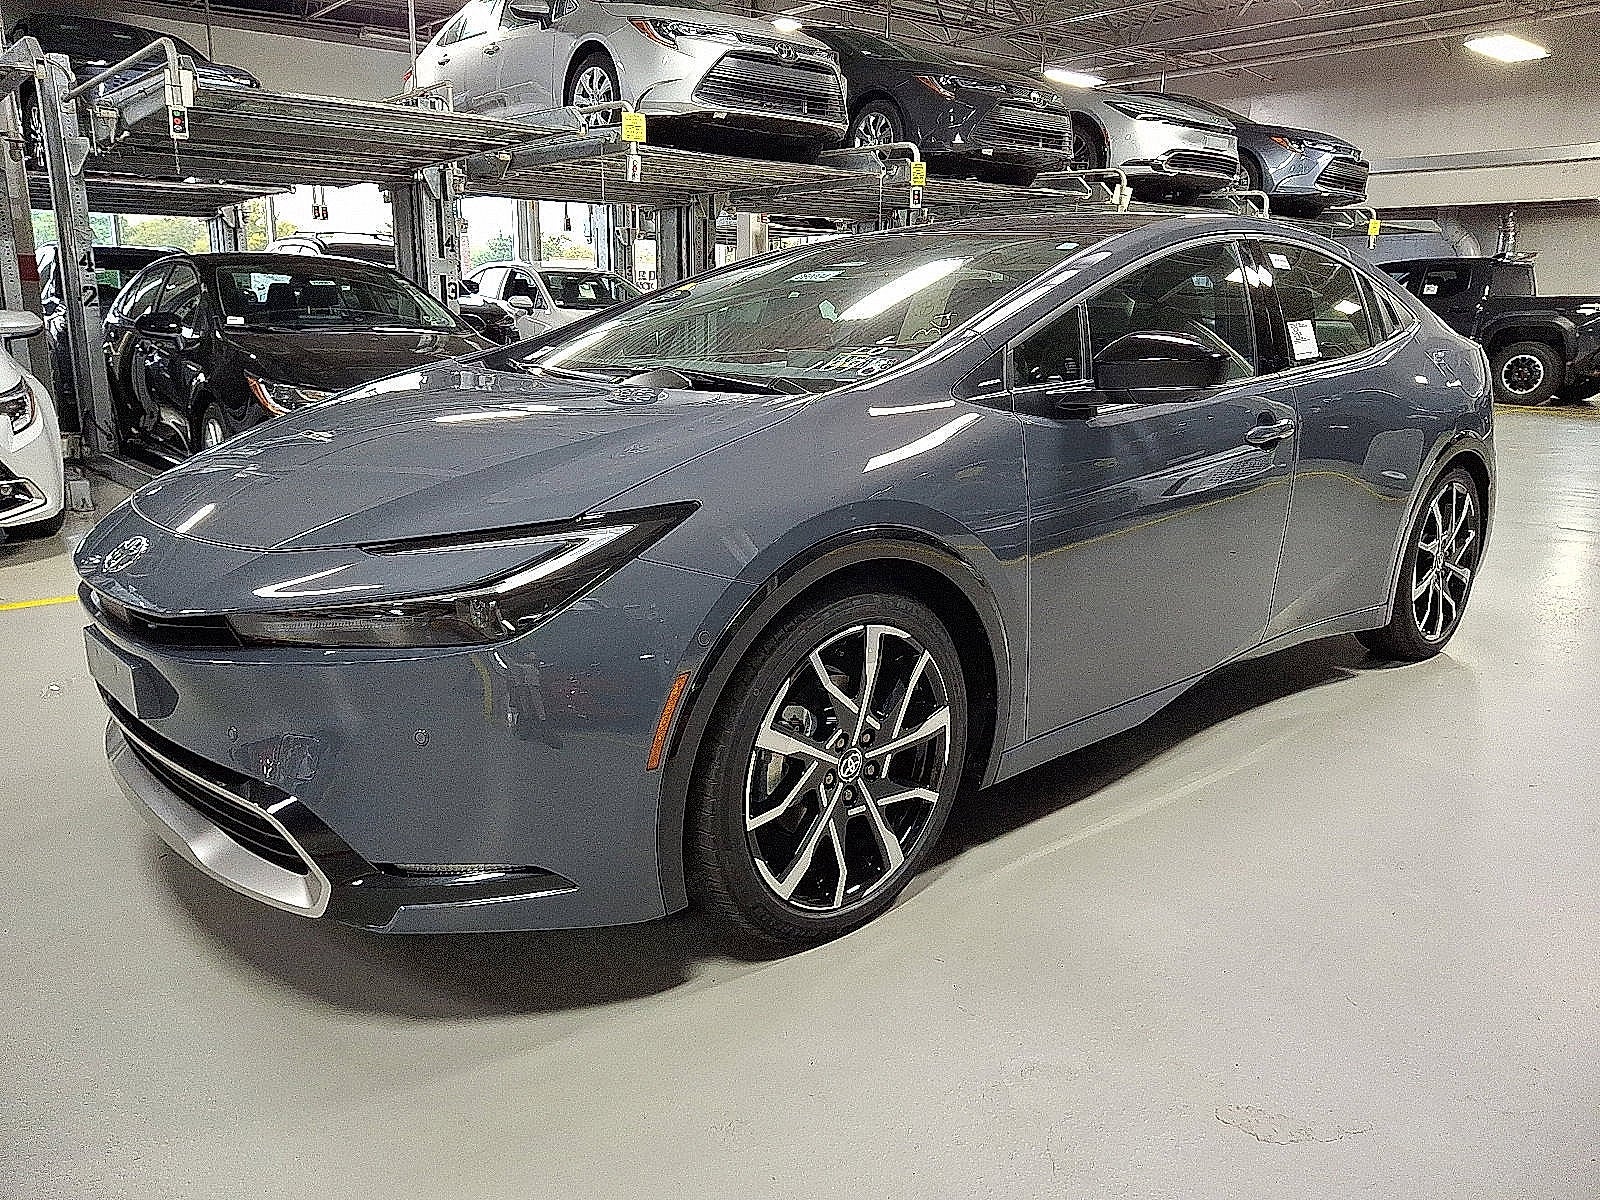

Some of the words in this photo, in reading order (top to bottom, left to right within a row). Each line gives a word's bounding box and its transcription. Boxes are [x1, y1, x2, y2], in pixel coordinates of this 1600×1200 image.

[445, 234, 456, 252] 4
[79, 250, 94, 272] 4
[82, 285, 99, 307] 2
[447, 282, 458, 300] 3
